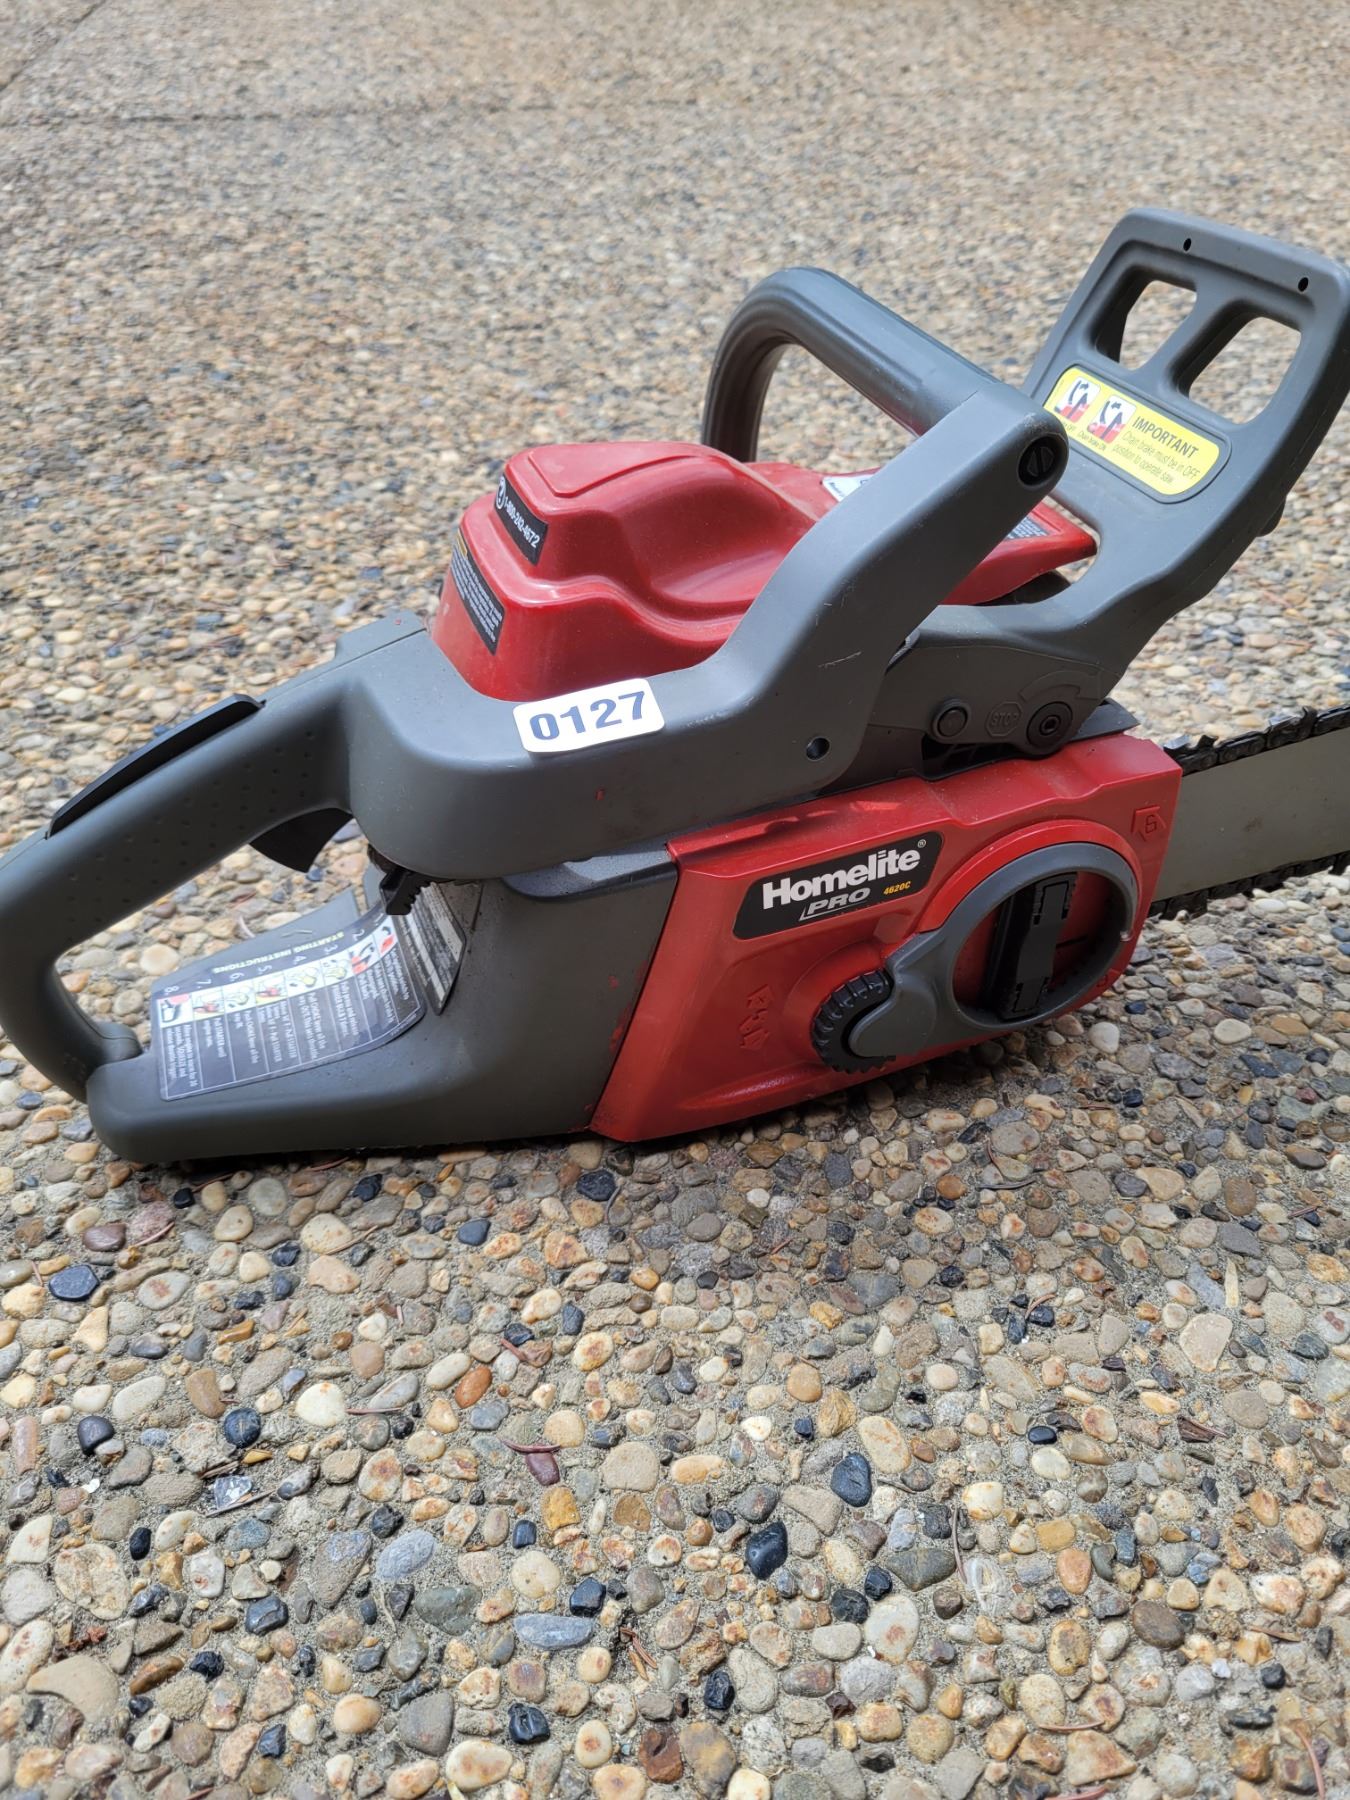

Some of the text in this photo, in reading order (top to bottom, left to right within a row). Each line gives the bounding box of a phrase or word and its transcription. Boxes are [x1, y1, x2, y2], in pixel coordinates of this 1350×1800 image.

[1132, 416, 1199, 458] IMPORTANT
[1182, 465, 1200, 482] OFF
[529, 691, 645, 740] 0127
[762, 849, 921, 910] Homelite
[806, 887, 871, 916] PRO
[212, 931, 345, 974] STARTING INSTRUCTIONS
[229, 972, 245, 982] 6.
[257, 964, 273, 975] 5.
[164, 985, 180, 995] 8.
[196, 978, 213, 989] 7.
